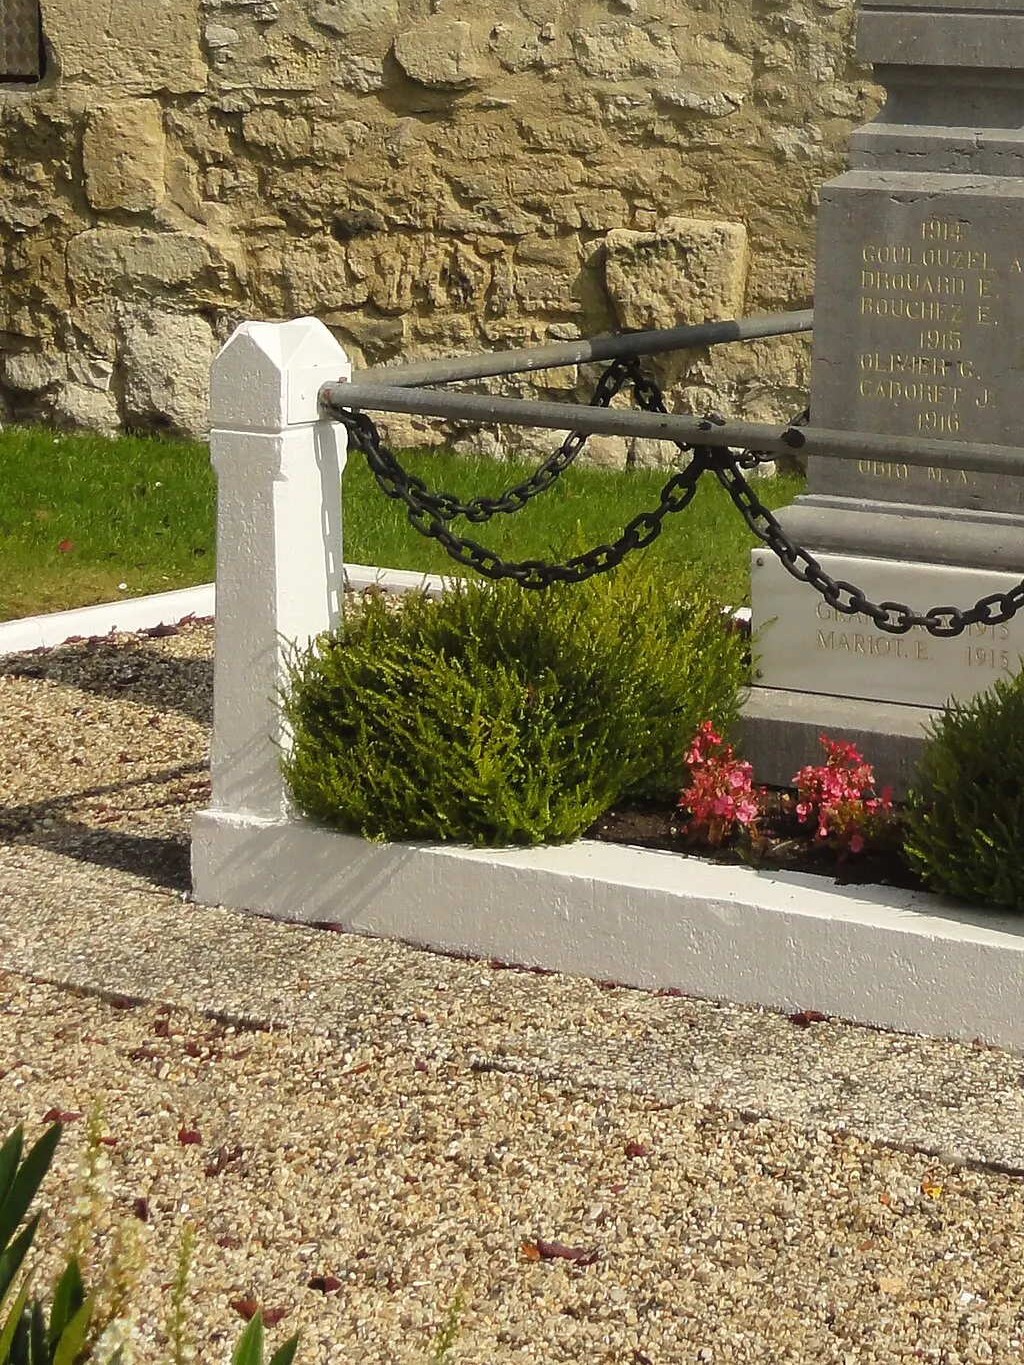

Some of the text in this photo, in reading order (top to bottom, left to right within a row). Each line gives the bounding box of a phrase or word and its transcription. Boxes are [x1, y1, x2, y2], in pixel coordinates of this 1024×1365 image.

[920, 219, 963, 243] 1914
[862, 244, 996, 273] GOULOUZEL
[861, 269, 966, 295] DROUARD
[861, 296, 999, 326] BOUCHEZ E.
[919, 329, 962, 352] 1915
[860, 351, 948, 377] OLIVIER
[975, 387, 996, 408] J.
[917, 410, 961, 433] 1916
